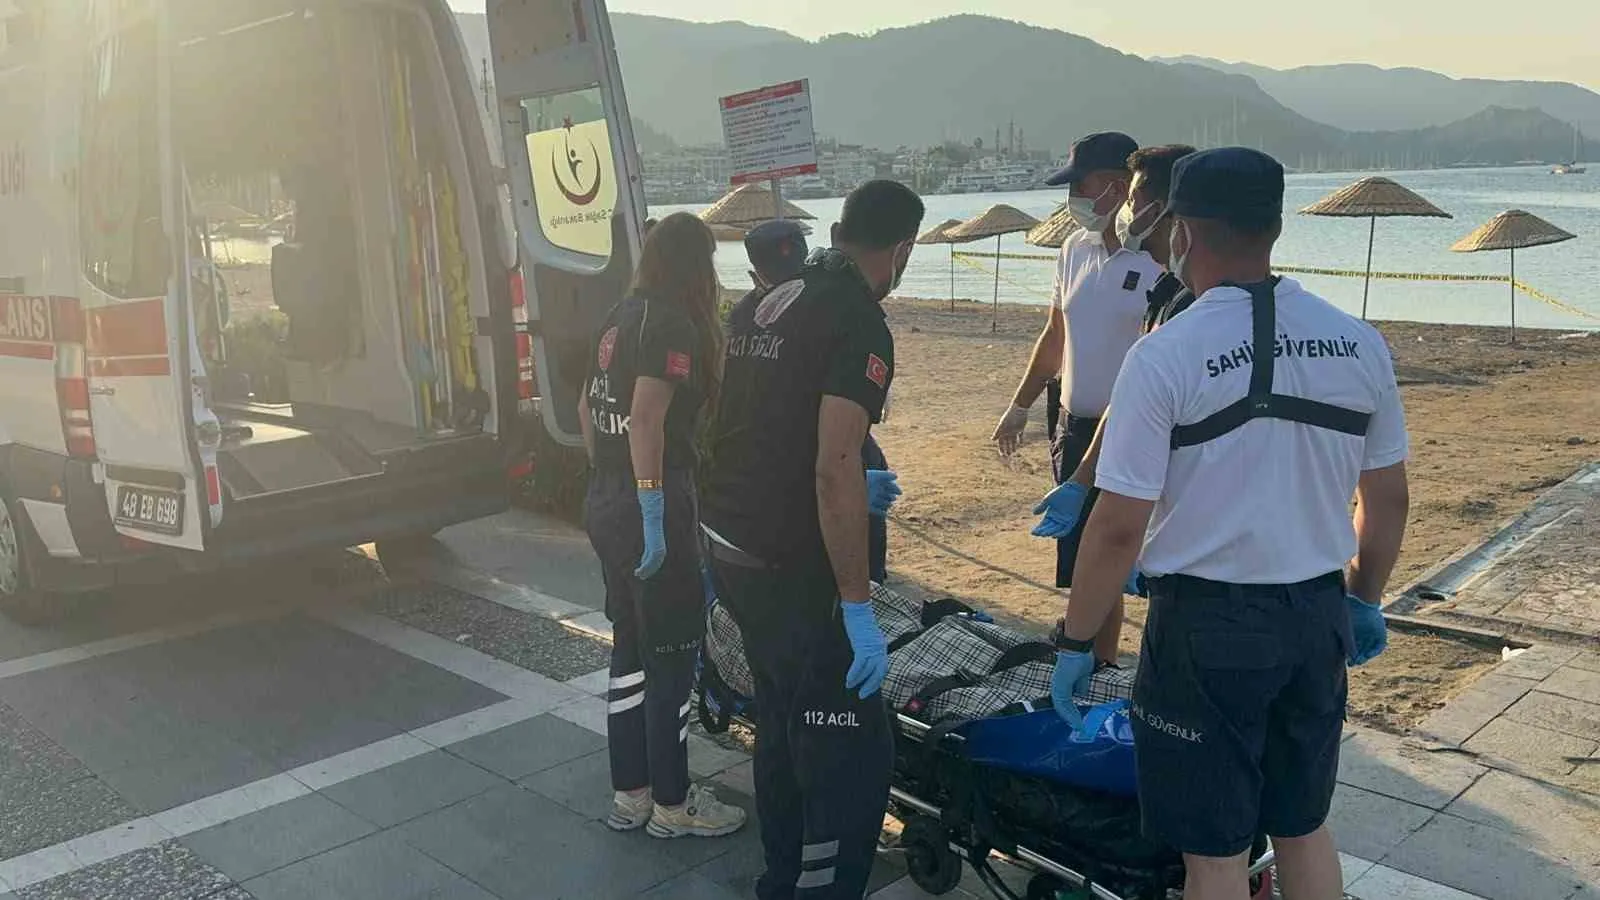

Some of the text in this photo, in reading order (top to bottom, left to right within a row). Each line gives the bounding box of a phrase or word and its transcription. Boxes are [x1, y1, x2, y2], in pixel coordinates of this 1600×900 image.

[1206, 339, 1255, 379] SAHİ
[122, 491, 177, 525] 48 EB 698
[803, 710, 861, 727] 112 ACİL
